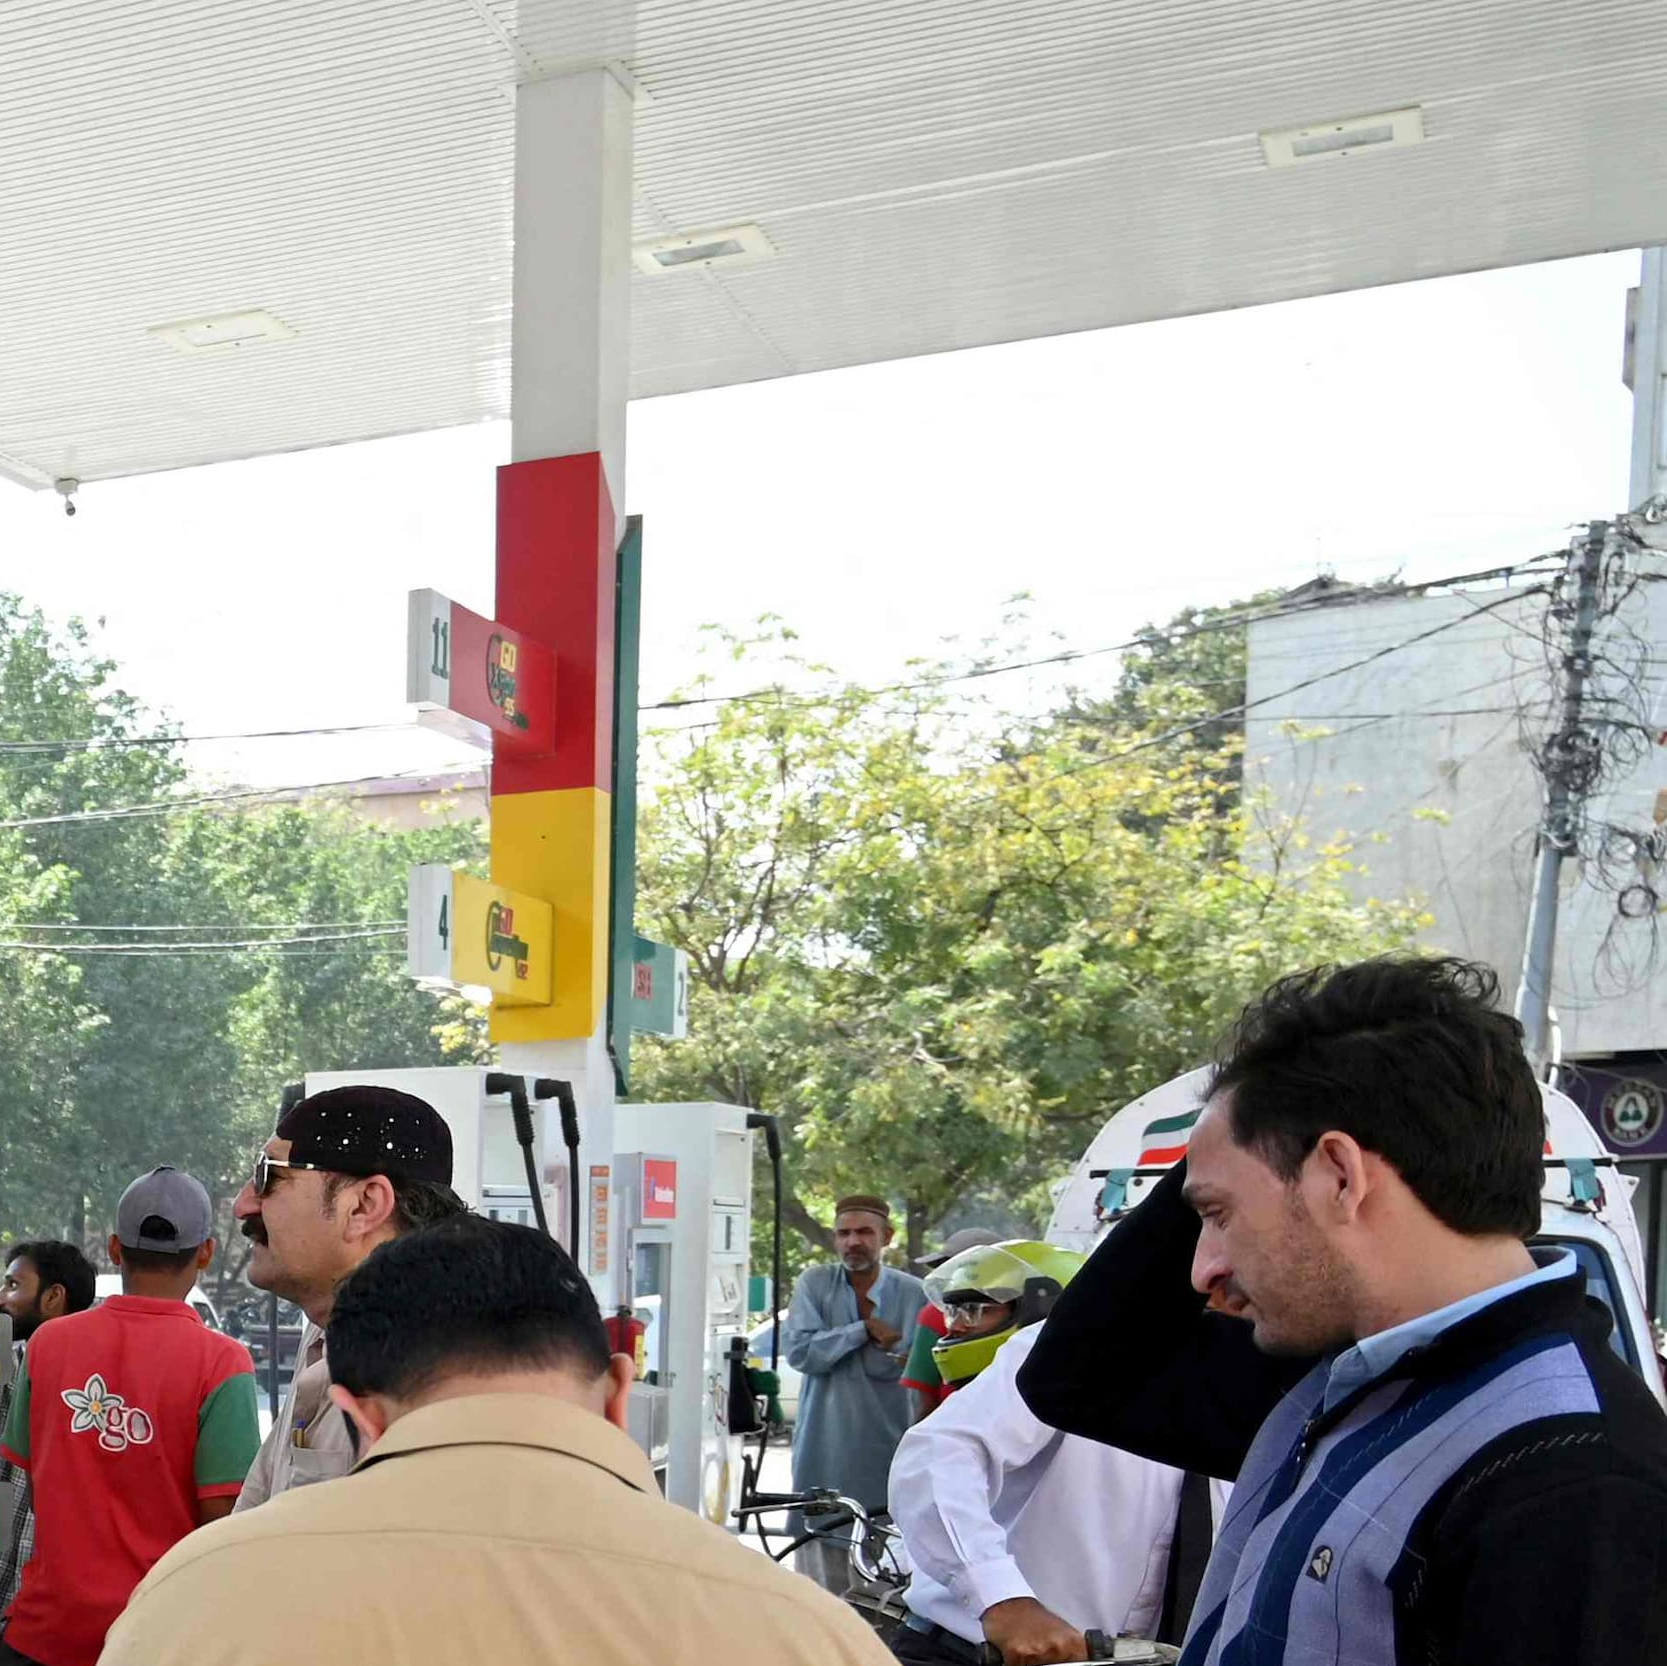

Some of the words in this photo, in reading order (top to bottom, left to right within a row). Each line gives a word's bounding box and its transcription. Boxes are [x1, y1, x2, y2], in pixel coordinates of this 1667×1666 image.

[432, 617, 448, 679] 11
[439, 894, 448, 951] 4
[99, 1406, 154, 1452] go
